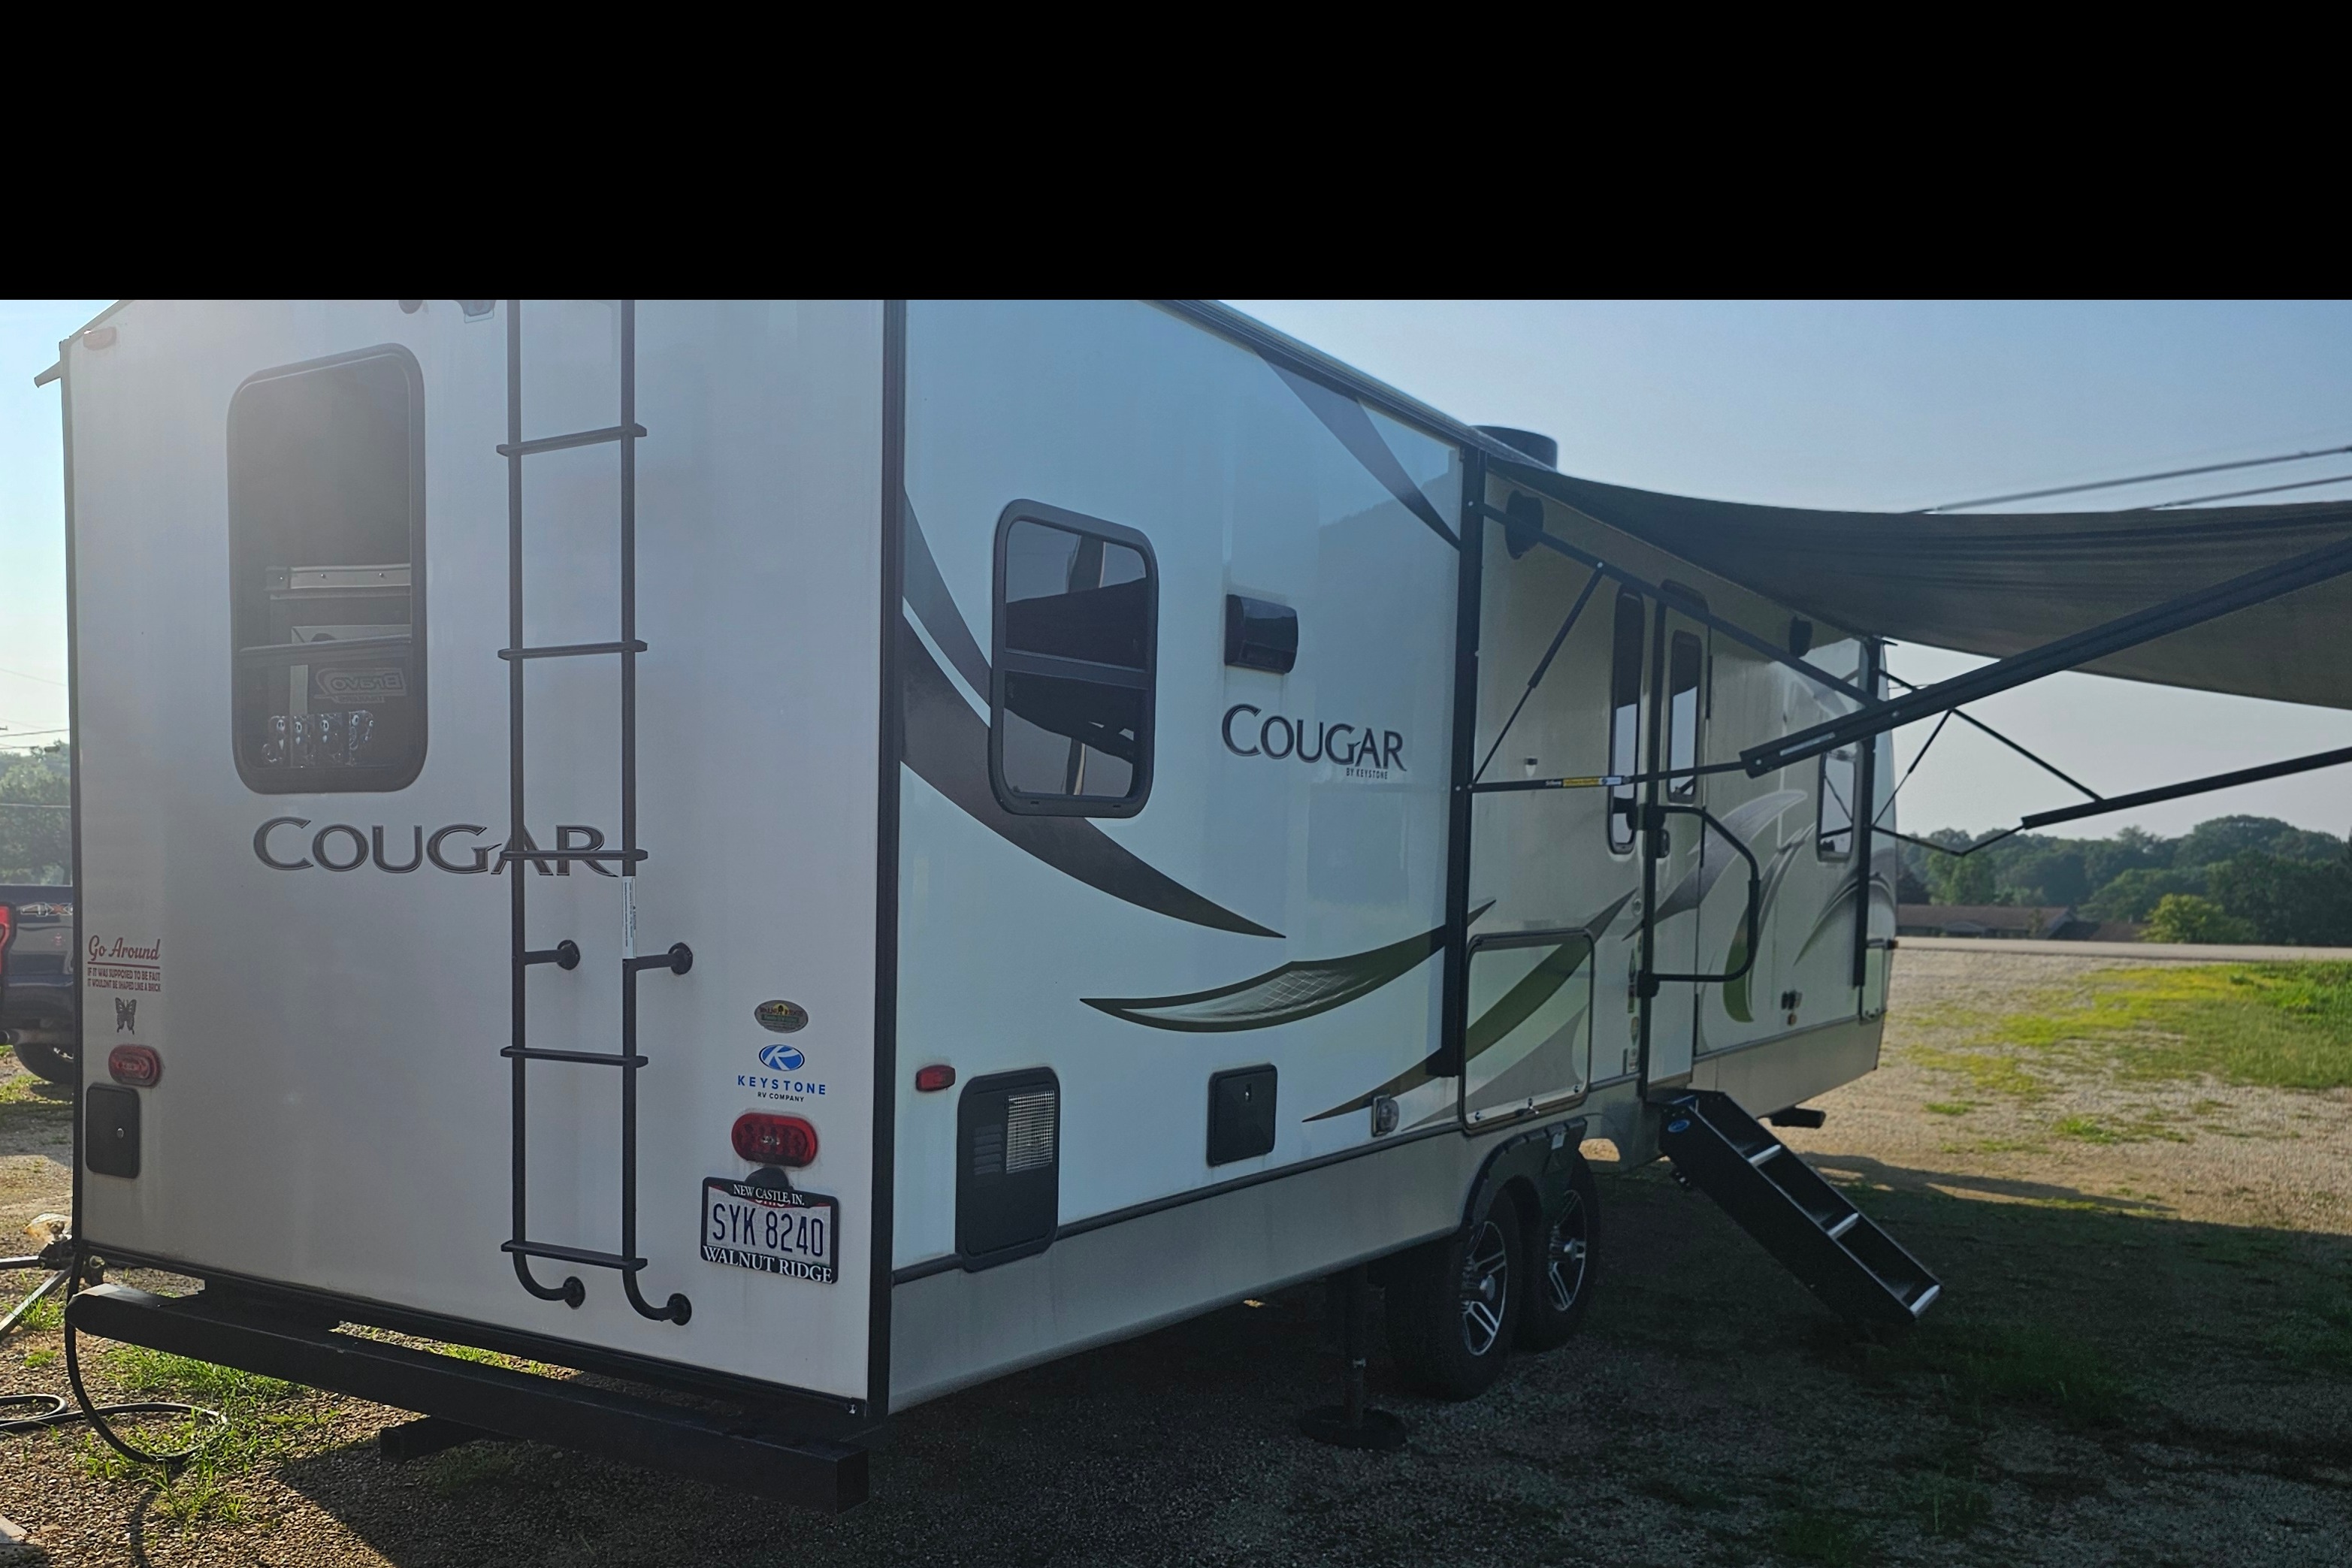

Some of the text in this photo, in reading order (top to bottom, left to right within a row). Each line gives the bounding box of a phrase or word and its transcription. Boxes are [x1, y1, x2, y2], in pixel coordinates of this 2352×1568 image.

[1221, 702, 1407, 772] COUGAR
[1346, 767, 1389, 780] BY KEYSTONE
[252, 815, 618, 878] COUGAR
[89, 935, 161, 961] Go Around
[87, 967, 161, 981] IF IT WAS SUPPOSED TO BE FAST
[112, 980, 118, 989] BE
[119, 980, 134, 990] SHAPED
[135, 982, 144, 991] LIKE
[148, 983, 161, 992] BRICK
[737, 1075, 826, 1095] KEYSTONE
[769, 1092, 805, 1102] COMPANY
[733, 1184, 754, 1197] NEW
[755, 1187, 791, 1204] CASTLE,
[791, 1193, 805, 1205] IN.
[712, 1203, 824, 1257] SYK 8240
[703, 1245, 833, 1284] WALNUT RIDGE
